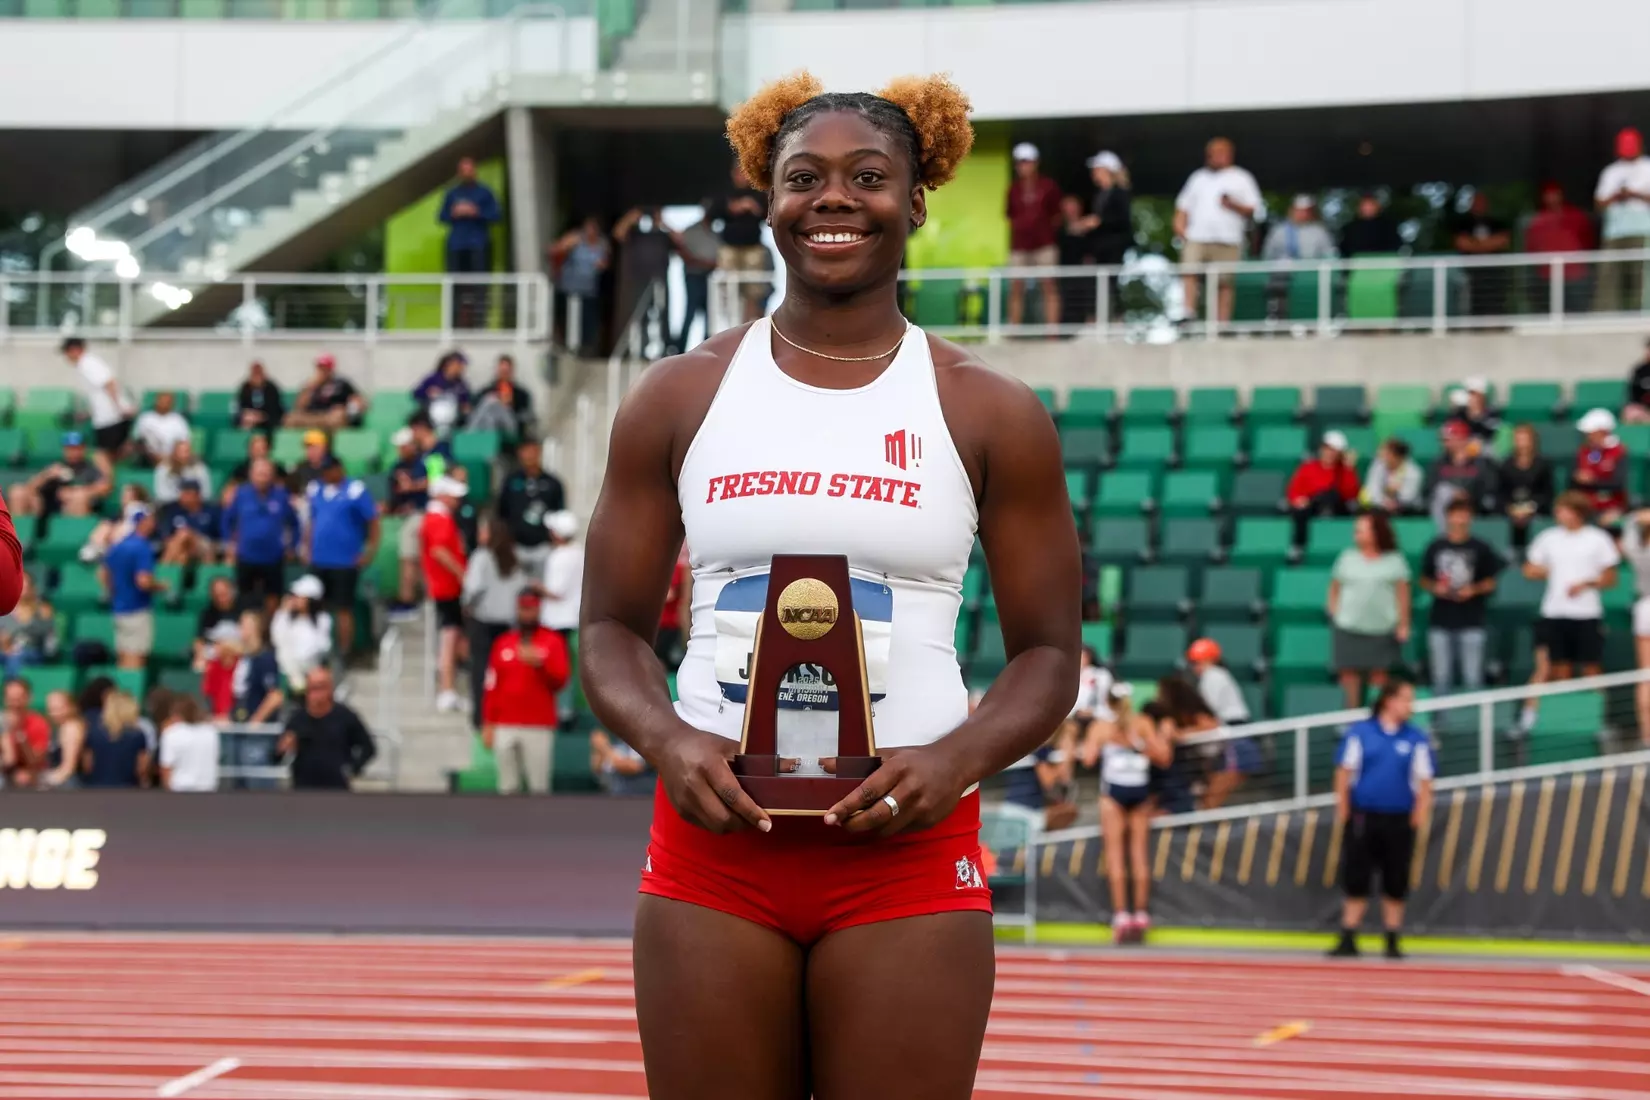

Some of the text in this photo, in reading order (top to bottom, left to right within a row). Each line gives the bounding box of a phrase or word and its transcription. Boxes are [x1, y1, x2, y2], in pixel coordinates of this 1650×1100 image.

[706, 471, 921, 508] FRESNO STATE
[782, 606, 834, 623] NCAA
[798, 676, 820, 685] 2025
[796, 693, 829, 704] OREGON
